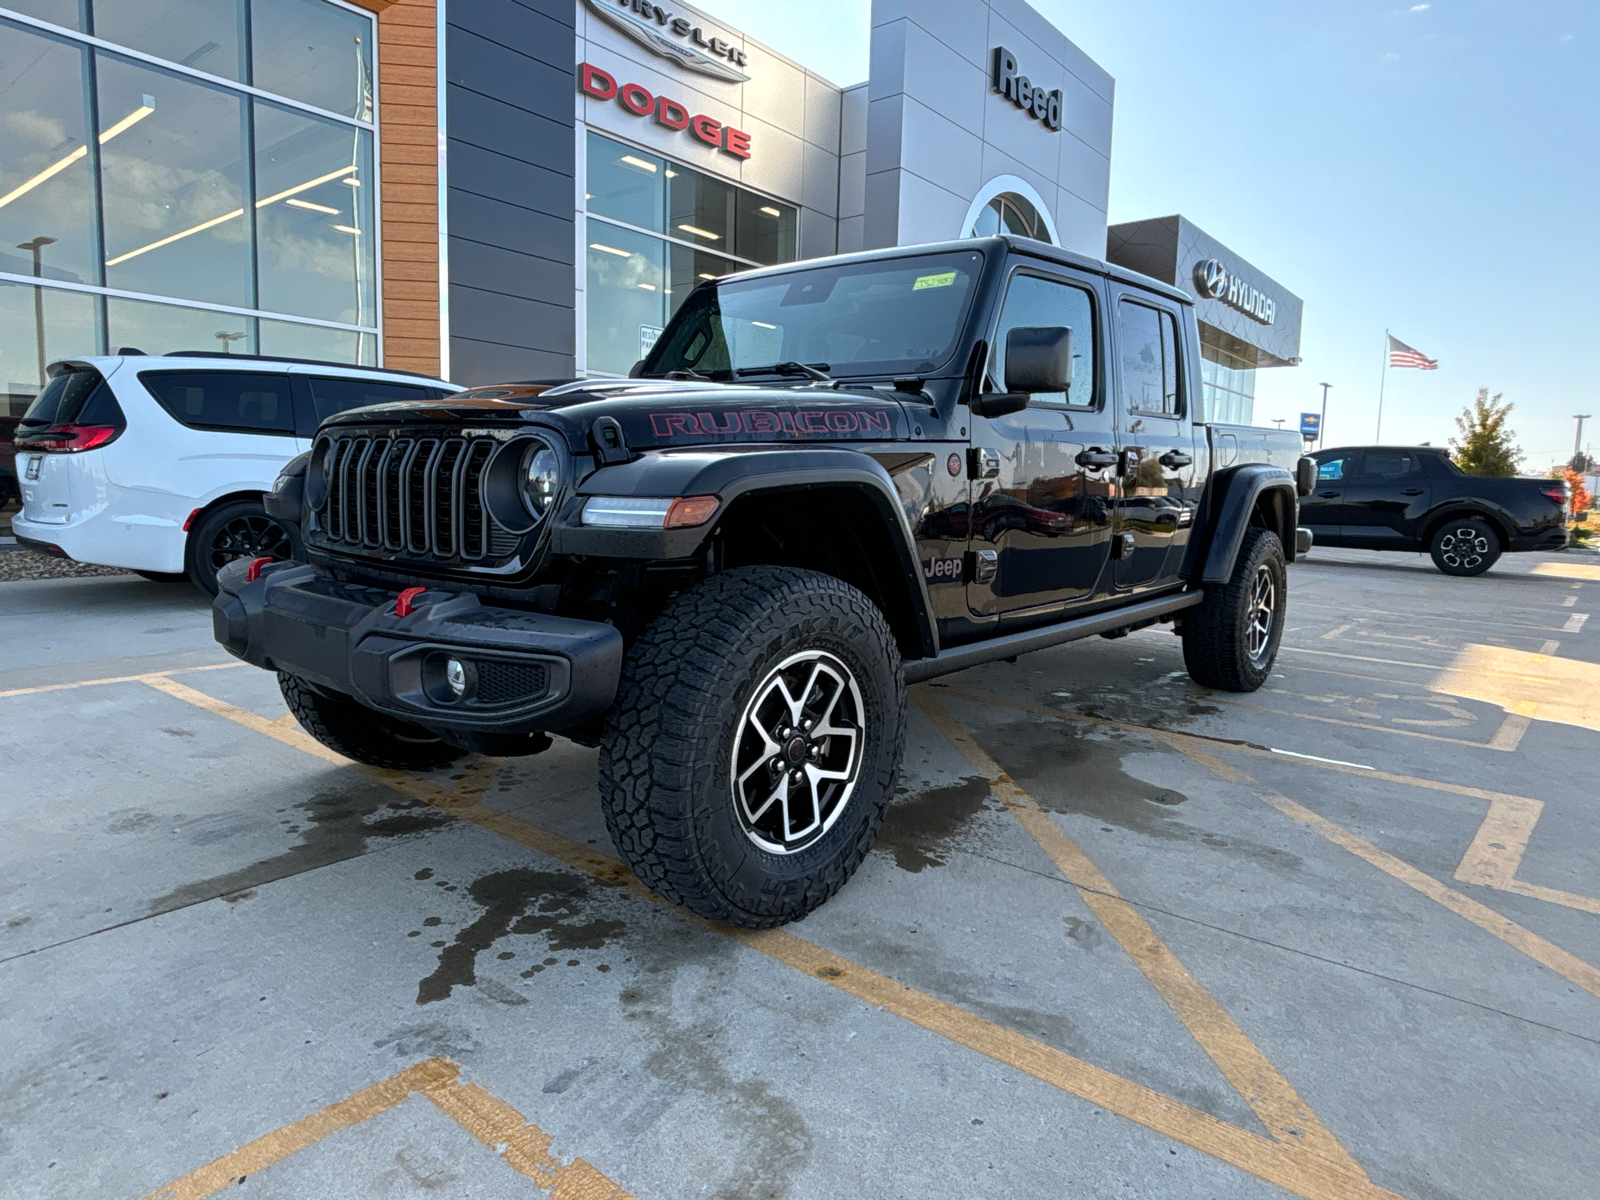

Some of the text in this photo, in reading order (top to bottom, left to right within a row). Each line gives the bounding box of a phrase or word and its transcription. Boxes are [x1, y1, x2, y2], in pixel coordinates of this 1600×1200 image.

[620, 0, 748, 66] RYSLER
[578, 61, 752, 160] DODGE
[994, 46, 1063, 132] Reed
[1227, 274, 1276, 325] HYUNDAI
[649, 411, 891, 437] RUBICON
[924, 556, 962, 579] Jeep
